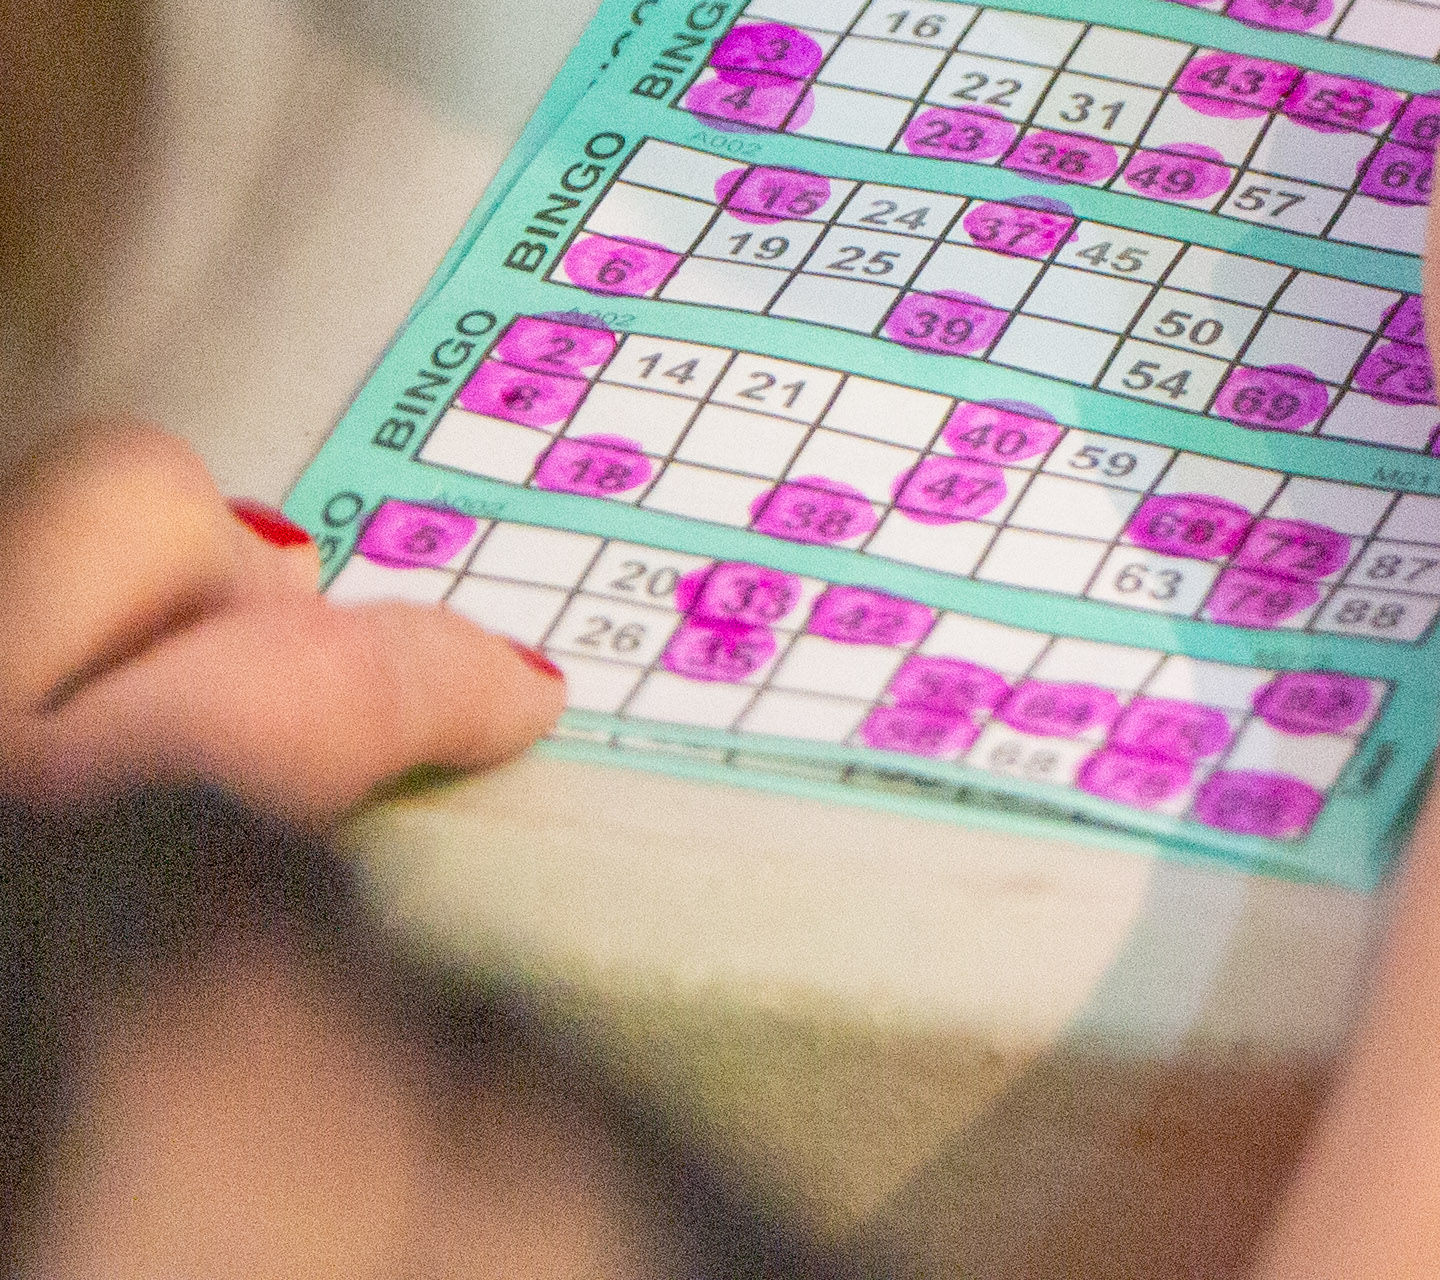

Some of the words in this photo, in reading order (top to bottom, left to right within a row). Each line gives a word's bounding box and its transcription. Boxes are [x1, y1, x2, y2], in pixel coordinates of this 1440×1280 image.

[754, 38, 793, 64] 3
[951, 71, 1024, 109] 22
[1059, 92, 1127, 131] 31
[885, 8, 947, 39] 16
[1197, 64, 1267, 96] 43
[503, 131, 626, 273] BINGO
[720, 85, 758, 111] 4
[915, 119, 986, 153] 23
[1128, 164, 1198, 195] 49
[1240, 185, 1307, 219] 57
[761, 181, 827, 217] 15
[860, 200, 930, 232] 24
[968, 217, 1038, 251] 37
[1077, 240, 1149, 274] 45
[594, 257, 636, 289] 6
[904, 309, 976, 345] 39
[1121, 359, 1193, 400] 54
[1232, 386, 1302, 423] 69
[726, 230, 791, 261] 19
[828, 244, 901, 276] 25
[1154, 308, 1226, 346] 50
[371, 309, 498, 451] BINGO
[536, 337, 577, 366] 2
[640, 351, 700, 386] 14
[738, 370, 807, 409] 21
[958, 423, 1030, 456] 40
[1067, 444, 1139, 477] 59
[568, 456, 635, 493] 18
[782, 502, 855, 537] 38
[1112, 561, 1184, 601] 63
[1334, 597, 1408, 629] 88
[611, 560, 682, 598] 20
[925, 472, 1000, 505] 47
[1258, 531, 1321, 571] 72
[576, 616, 642, 652] 26
